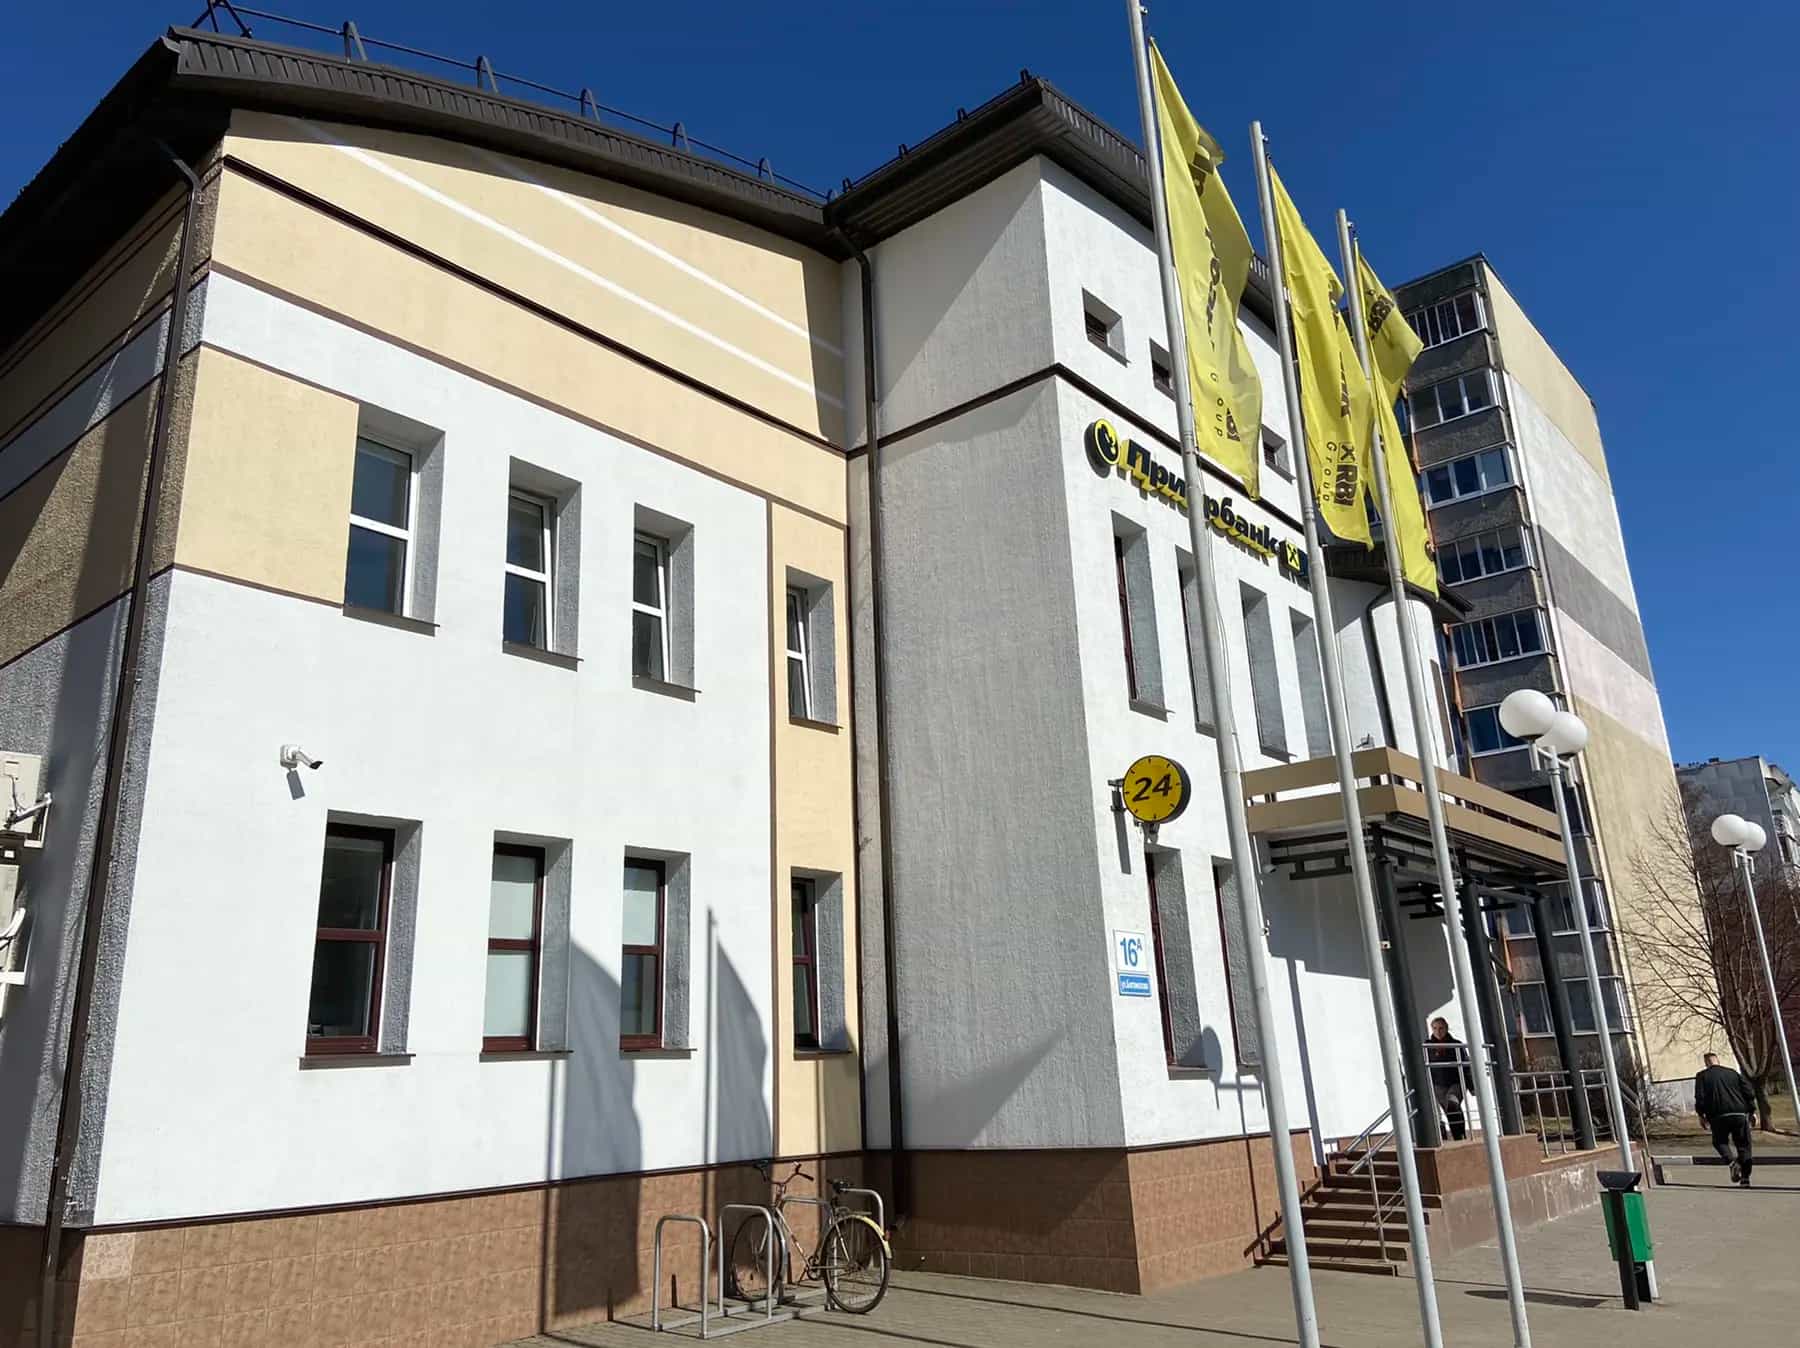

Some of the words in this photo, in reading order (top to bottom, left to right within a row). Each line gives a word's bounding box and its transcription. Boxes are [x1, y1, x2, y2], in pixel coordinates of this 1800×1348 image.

[1126, 439, 1281, 554] Прирбанк
[1322, 441, 1338, 502] Group
[1334, 464, 1358, 506] RBI
[1132, 773, 1173, 802] 24
